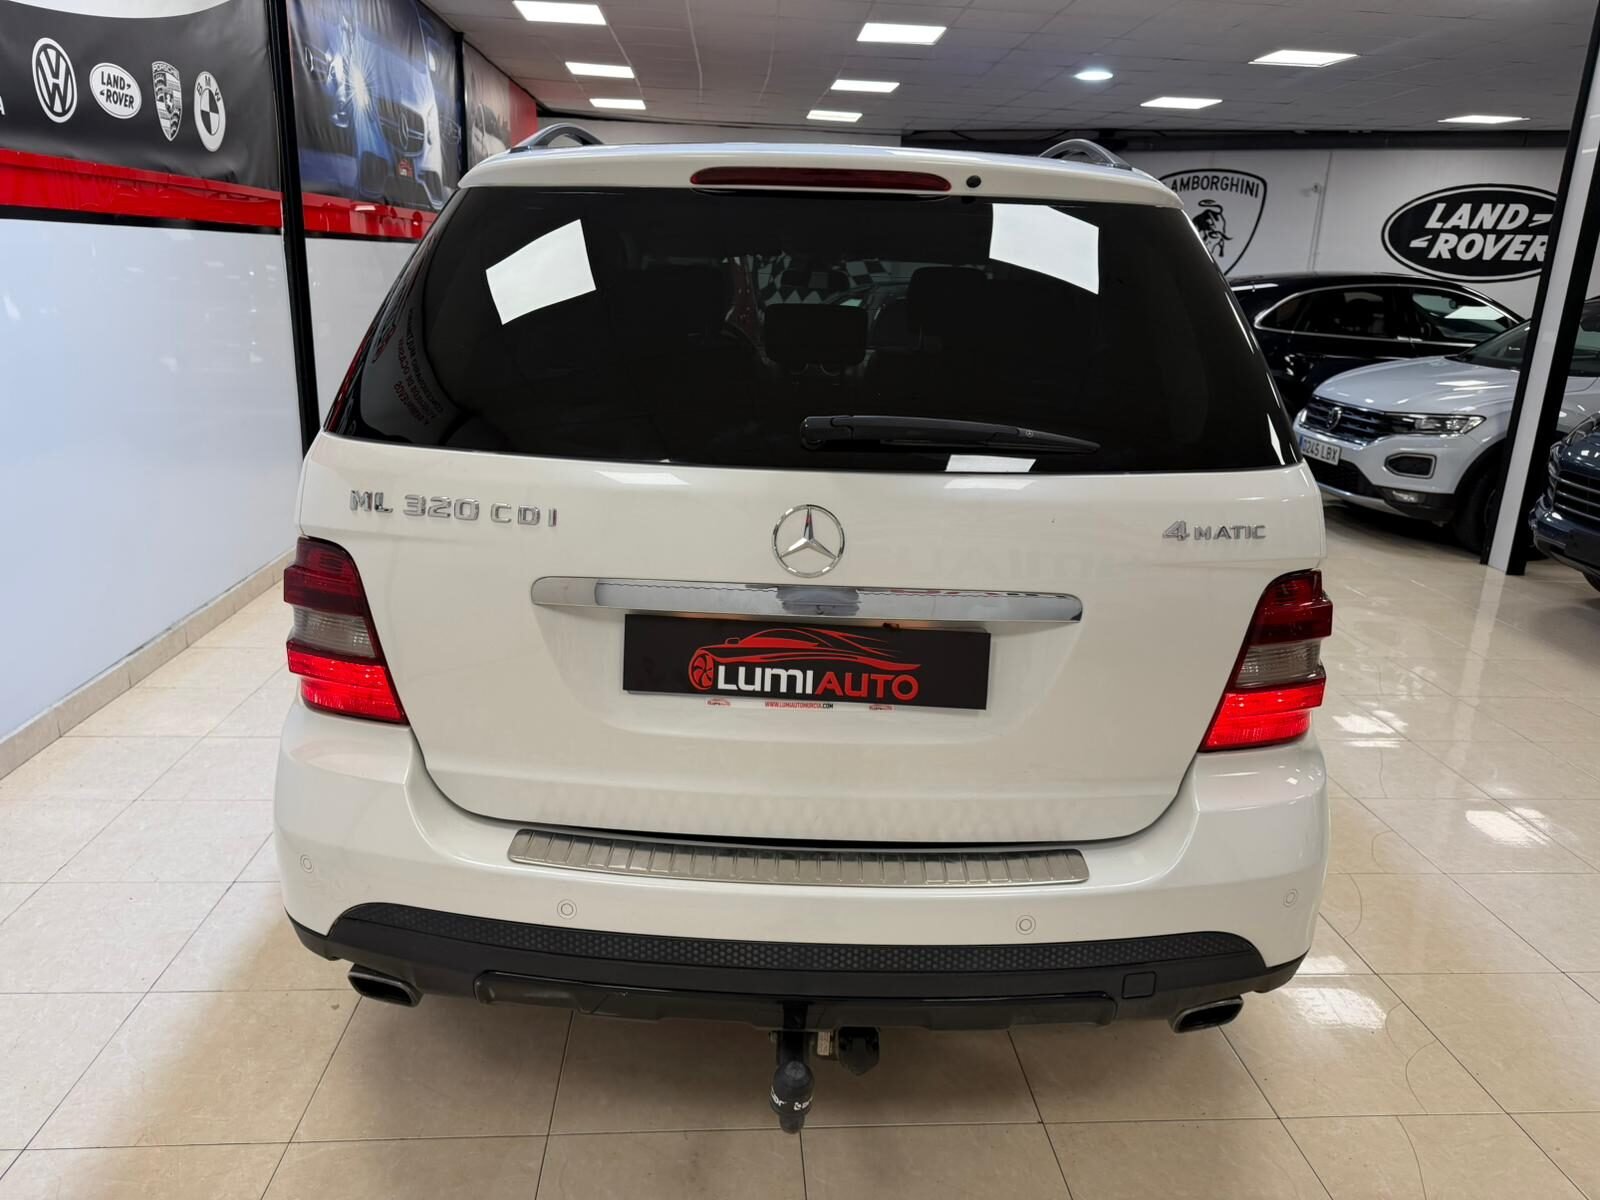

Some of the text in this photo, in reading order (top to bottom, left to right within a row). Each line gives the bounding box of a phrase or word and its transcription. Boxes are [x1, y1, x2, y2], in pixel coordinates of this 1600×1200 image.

[101, 71, 125, 90] LAND
[106, 89, 134, 110] ROVER
[1165, 175, 1259, 198] AMBORGHINI
[1424, 203, 1529, 230] LAND
[1427, 232, 1549, 262] ROVER
[1320, 445, 1338, 461] LBX
[350, 490, 557, 527] ML 320 CDI
